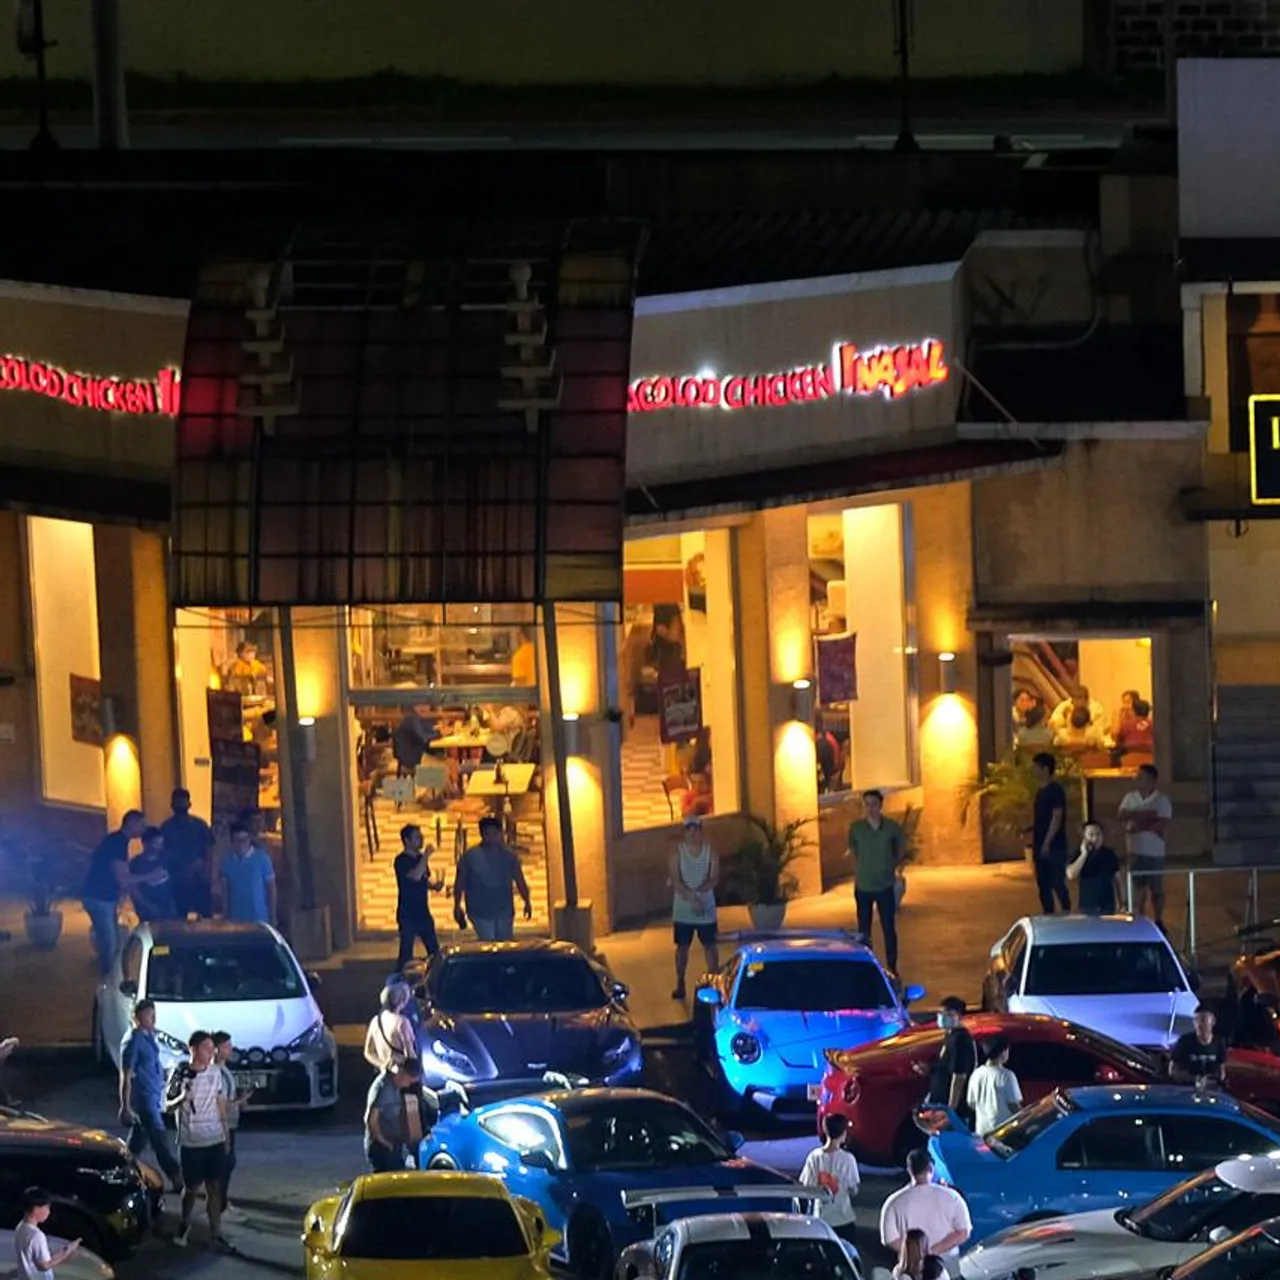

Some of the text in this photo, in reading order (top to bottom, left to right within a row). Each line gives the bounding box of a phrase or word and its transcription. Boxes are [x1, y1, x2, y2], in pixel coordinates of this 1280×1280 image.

[63, 371, 157, 414] CHICKEN
[627, 375, 722, 412] ACOLOD
[723, 366, 833, 410] CHICKEN
